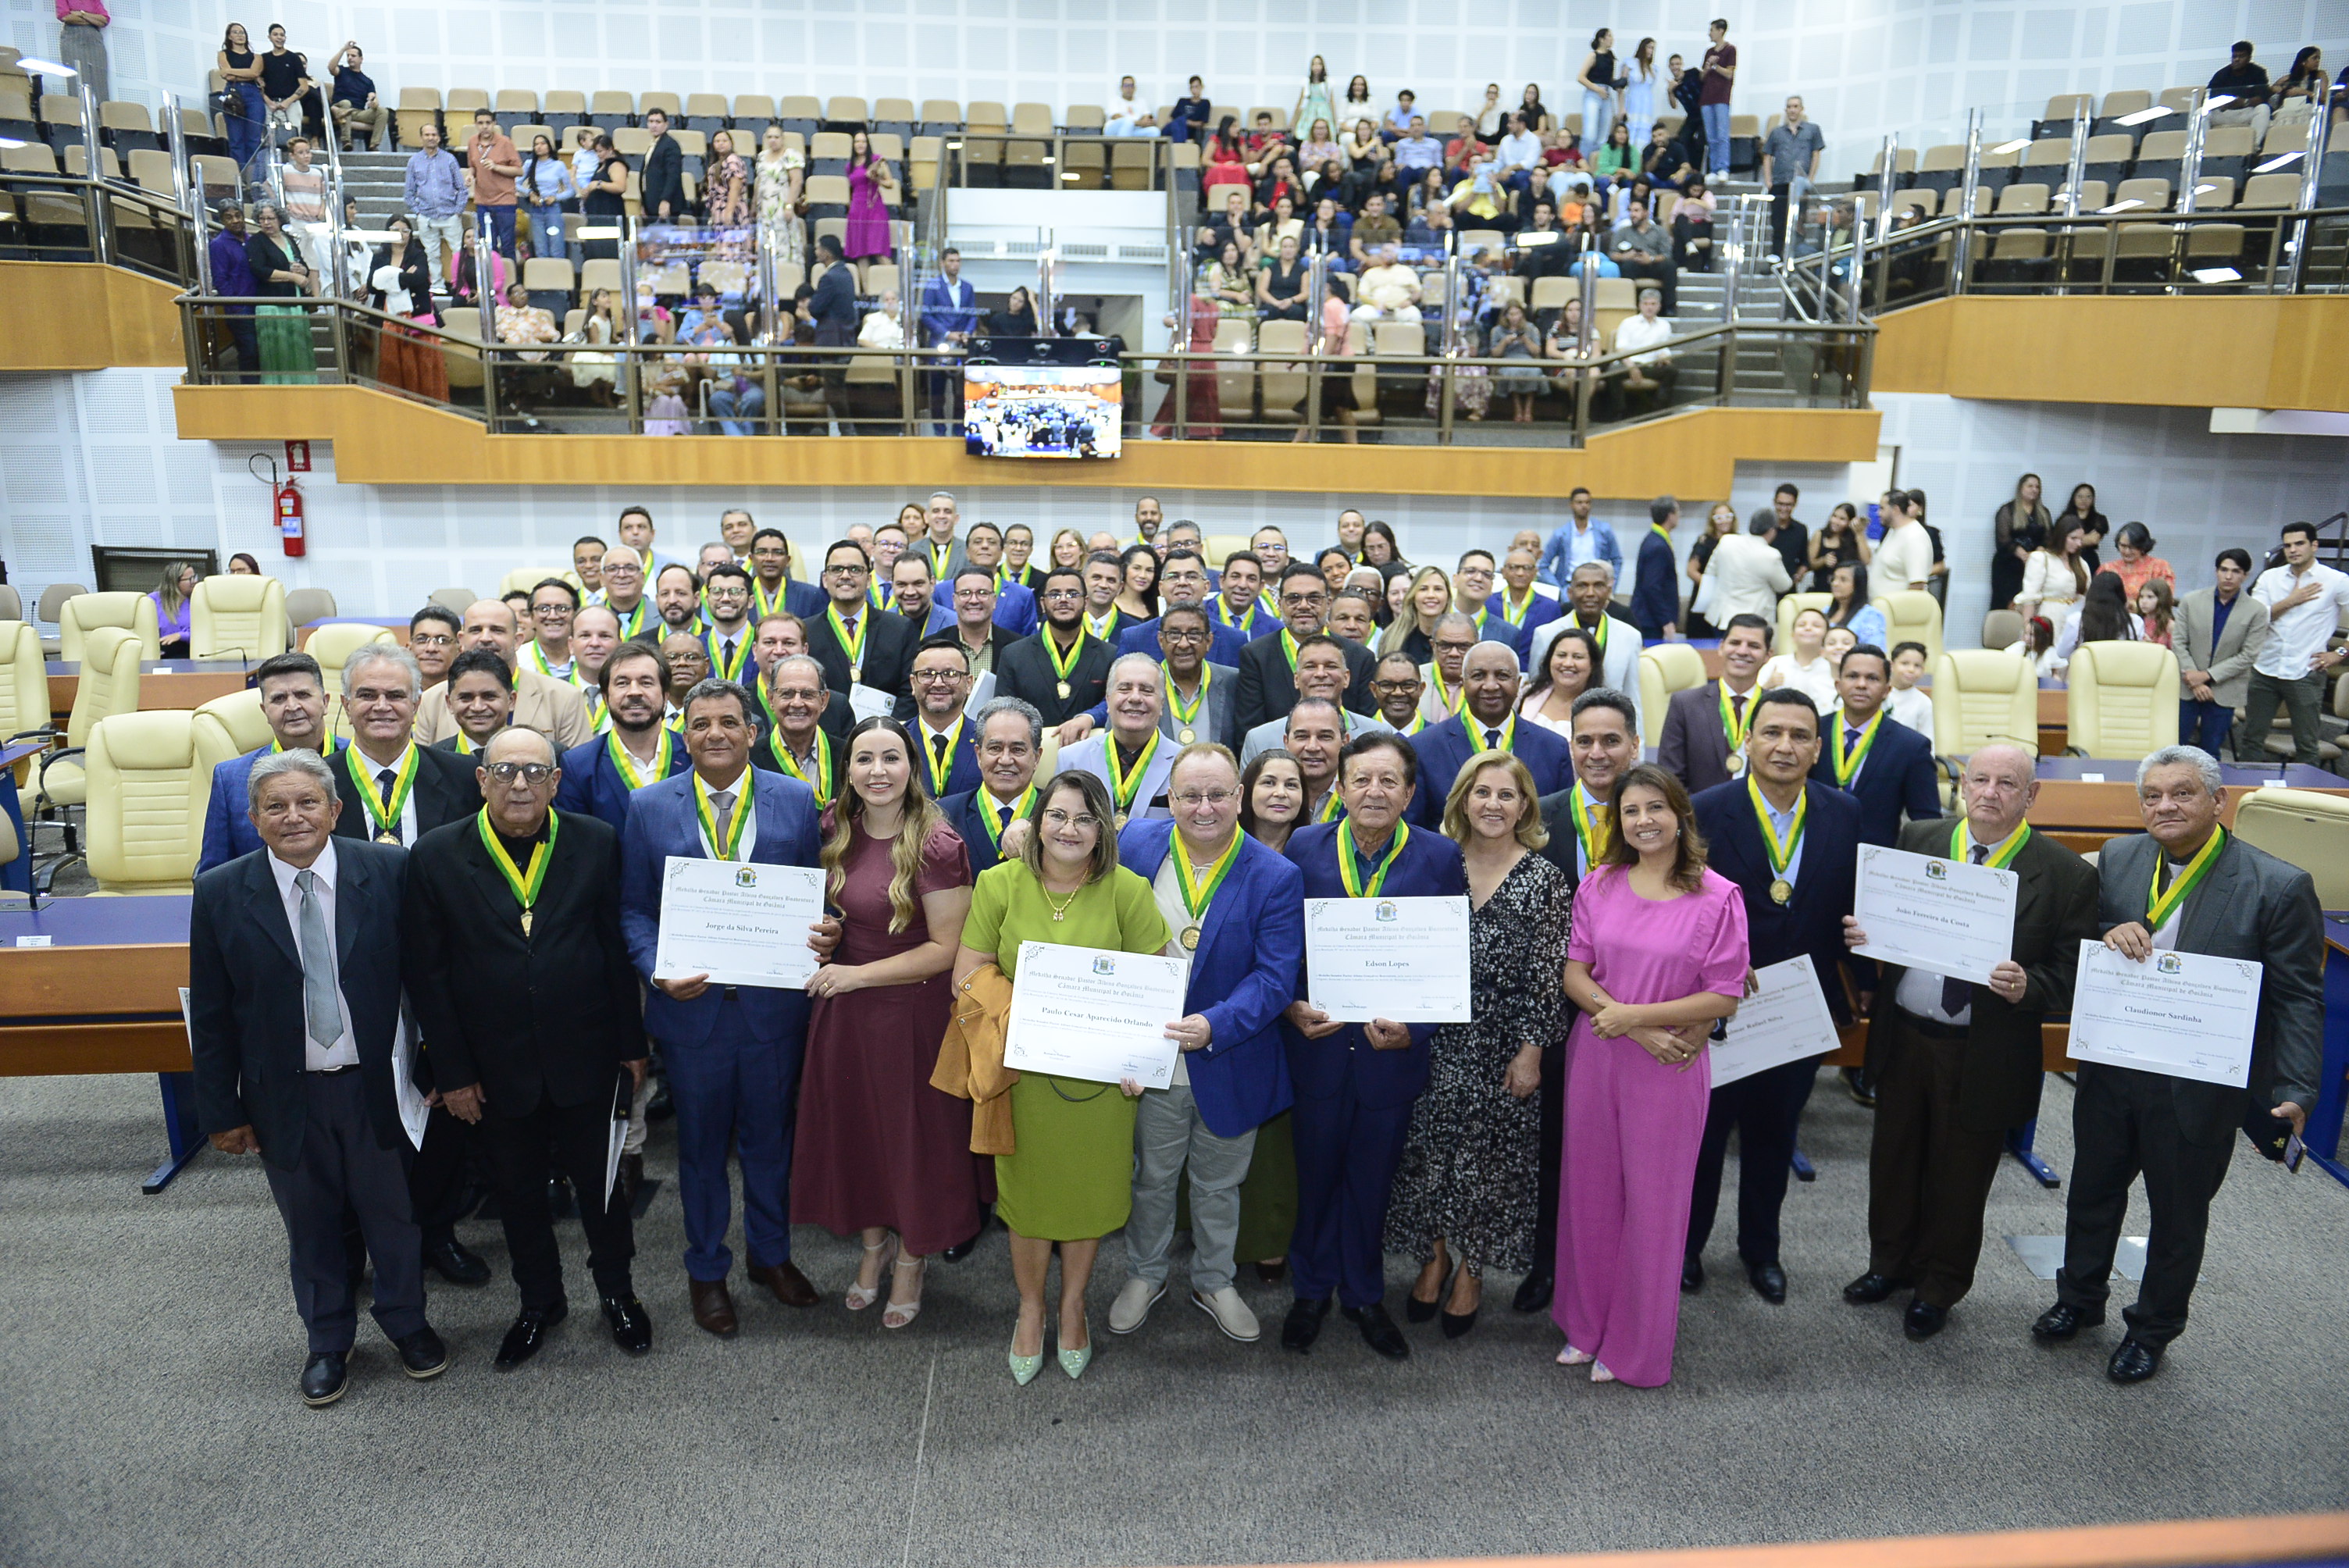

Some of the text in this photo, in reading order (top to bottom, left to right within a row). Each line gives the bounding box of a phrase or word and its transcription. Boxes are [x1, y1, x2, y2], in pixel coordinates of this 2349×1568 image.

[706, 922, 725, 931] Jorge
[1913, 911, 1939, 921] Ferreira
[1951, 920, 1970, 928] Costa
[1042, 1007, 1063, 1016] Paulo
[1064, 1010, 1084, 1018] Cesar
[1085, 1013, 1122, 1025] Aparecido
[1124, 1018, 1153, 1028] Orlando
[2124, 1006, 2166, 1017] Claudionor
[2168, 1012, 2202, 1024] Sardinha
